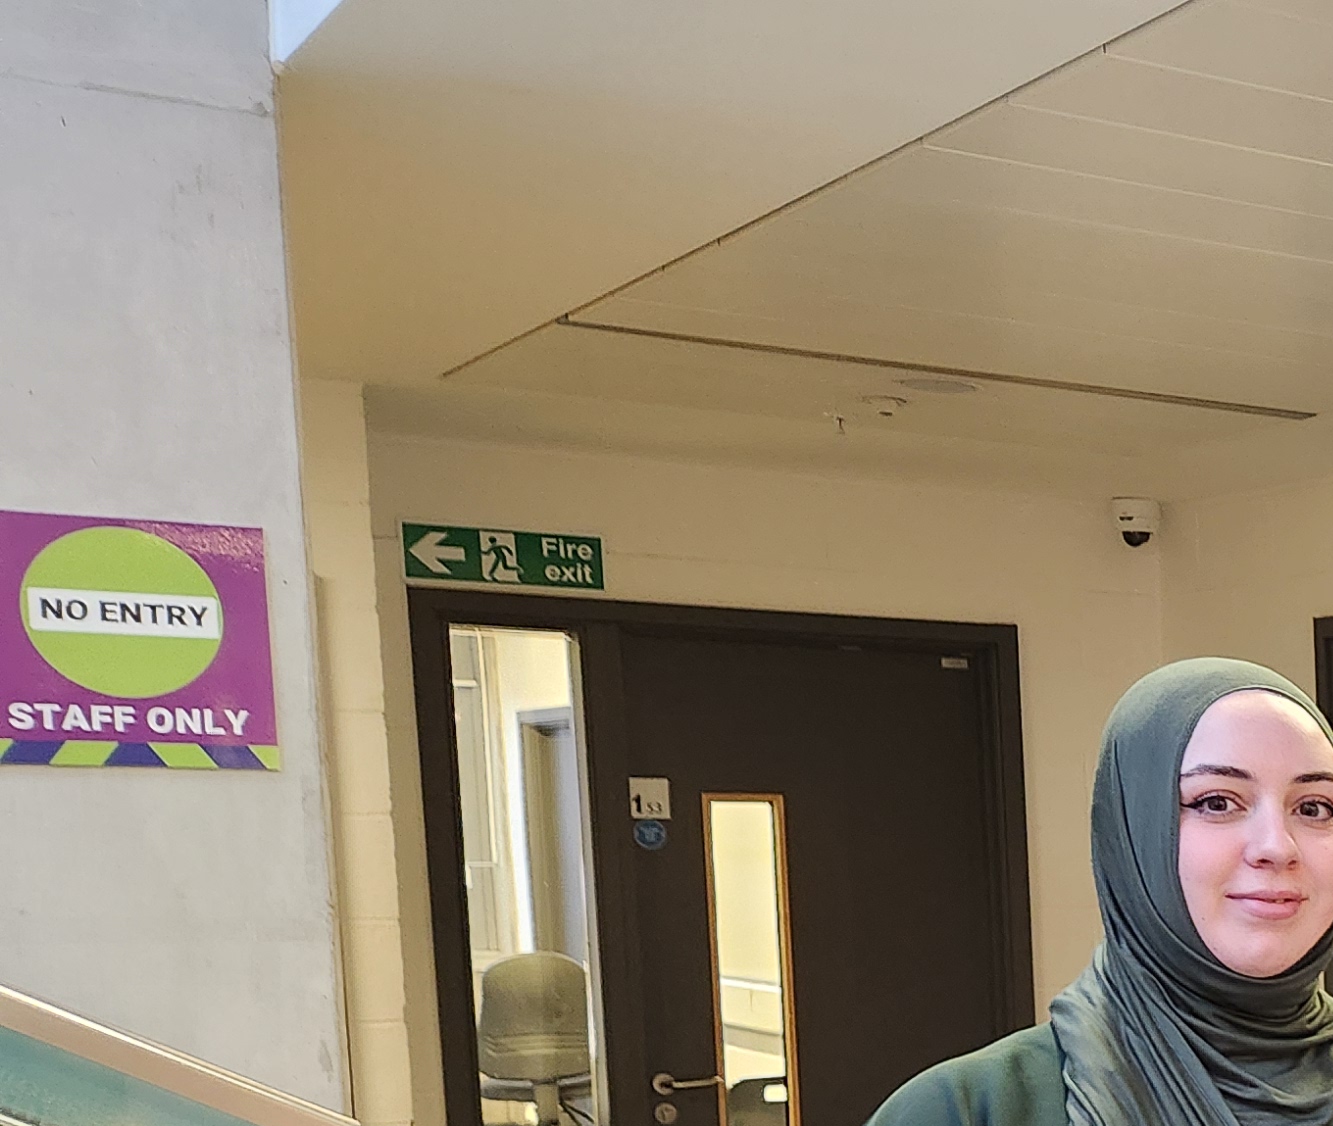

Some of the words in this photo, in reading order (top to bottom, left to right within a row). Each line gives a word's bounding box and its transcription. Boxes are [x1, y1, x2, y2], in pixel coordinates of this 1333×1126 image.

[541, 537, 594, 562] Fire
[544, 563, 593, 583] exit
[40, 597, 88, 621] NO
[100, 600, 209, 628] ENTRY
[8, 702, 136, 733] STAFF
[147, 706, 249, 736] ONLY
